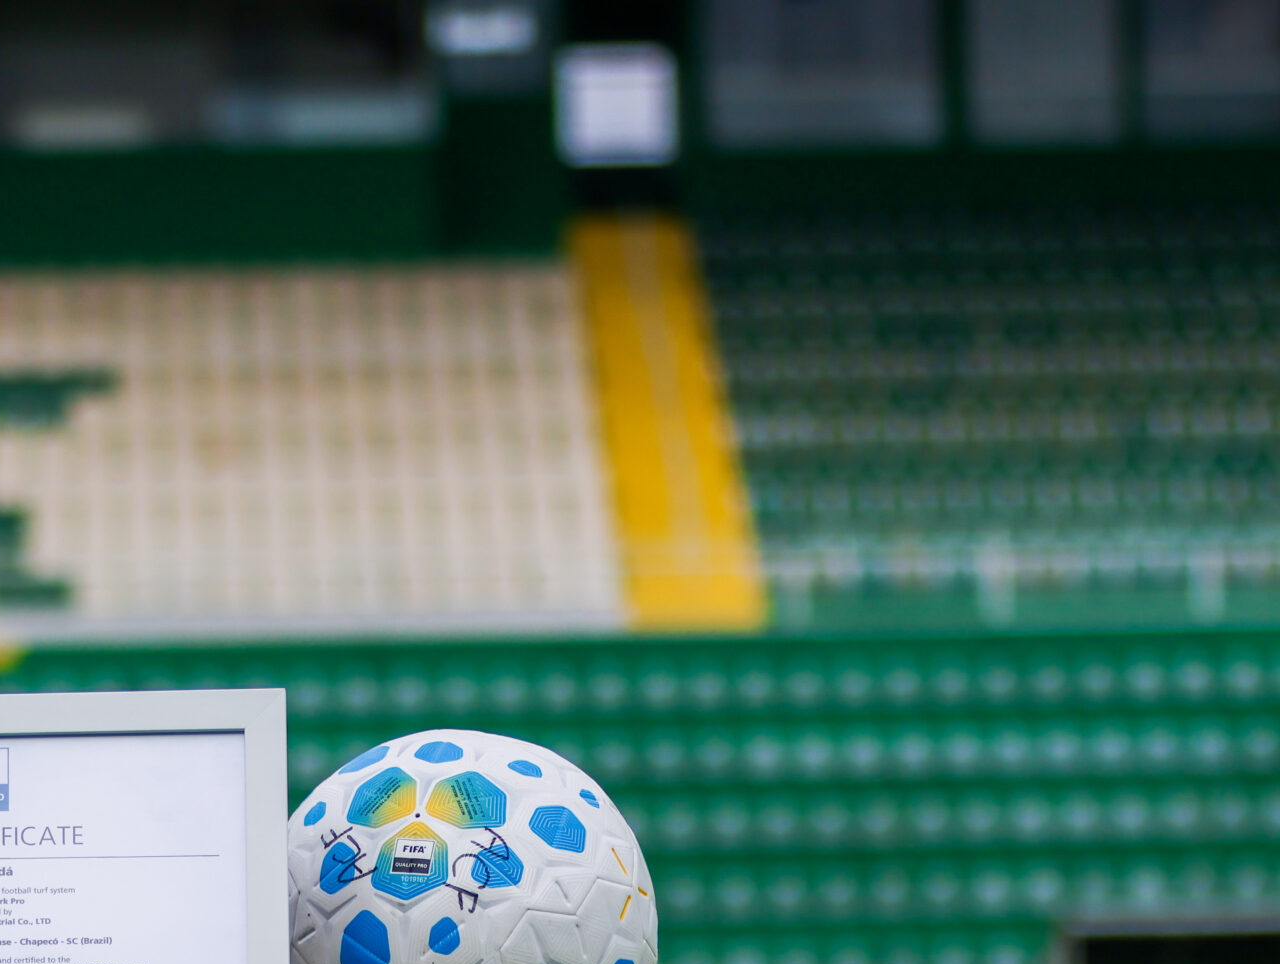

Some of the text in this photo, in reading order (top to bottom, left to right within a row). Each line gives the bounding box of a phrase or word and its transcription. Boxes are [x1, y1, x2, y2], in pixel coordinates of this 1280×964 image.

[1, 887, 32, 895] football
[33, 886, 49, 895] turf
[49, 887, 76, 896] system
[9, 897, 26, 905] Pro
[2, 907, 13, 917] by
[19, 936, 60, 948] Chapecó
[65, 937, 79, 945] SC
[80, 936, 113, 946] (Brazil)
[13, 955, 46, 964] certified
[57, 955, 71, 963] the
